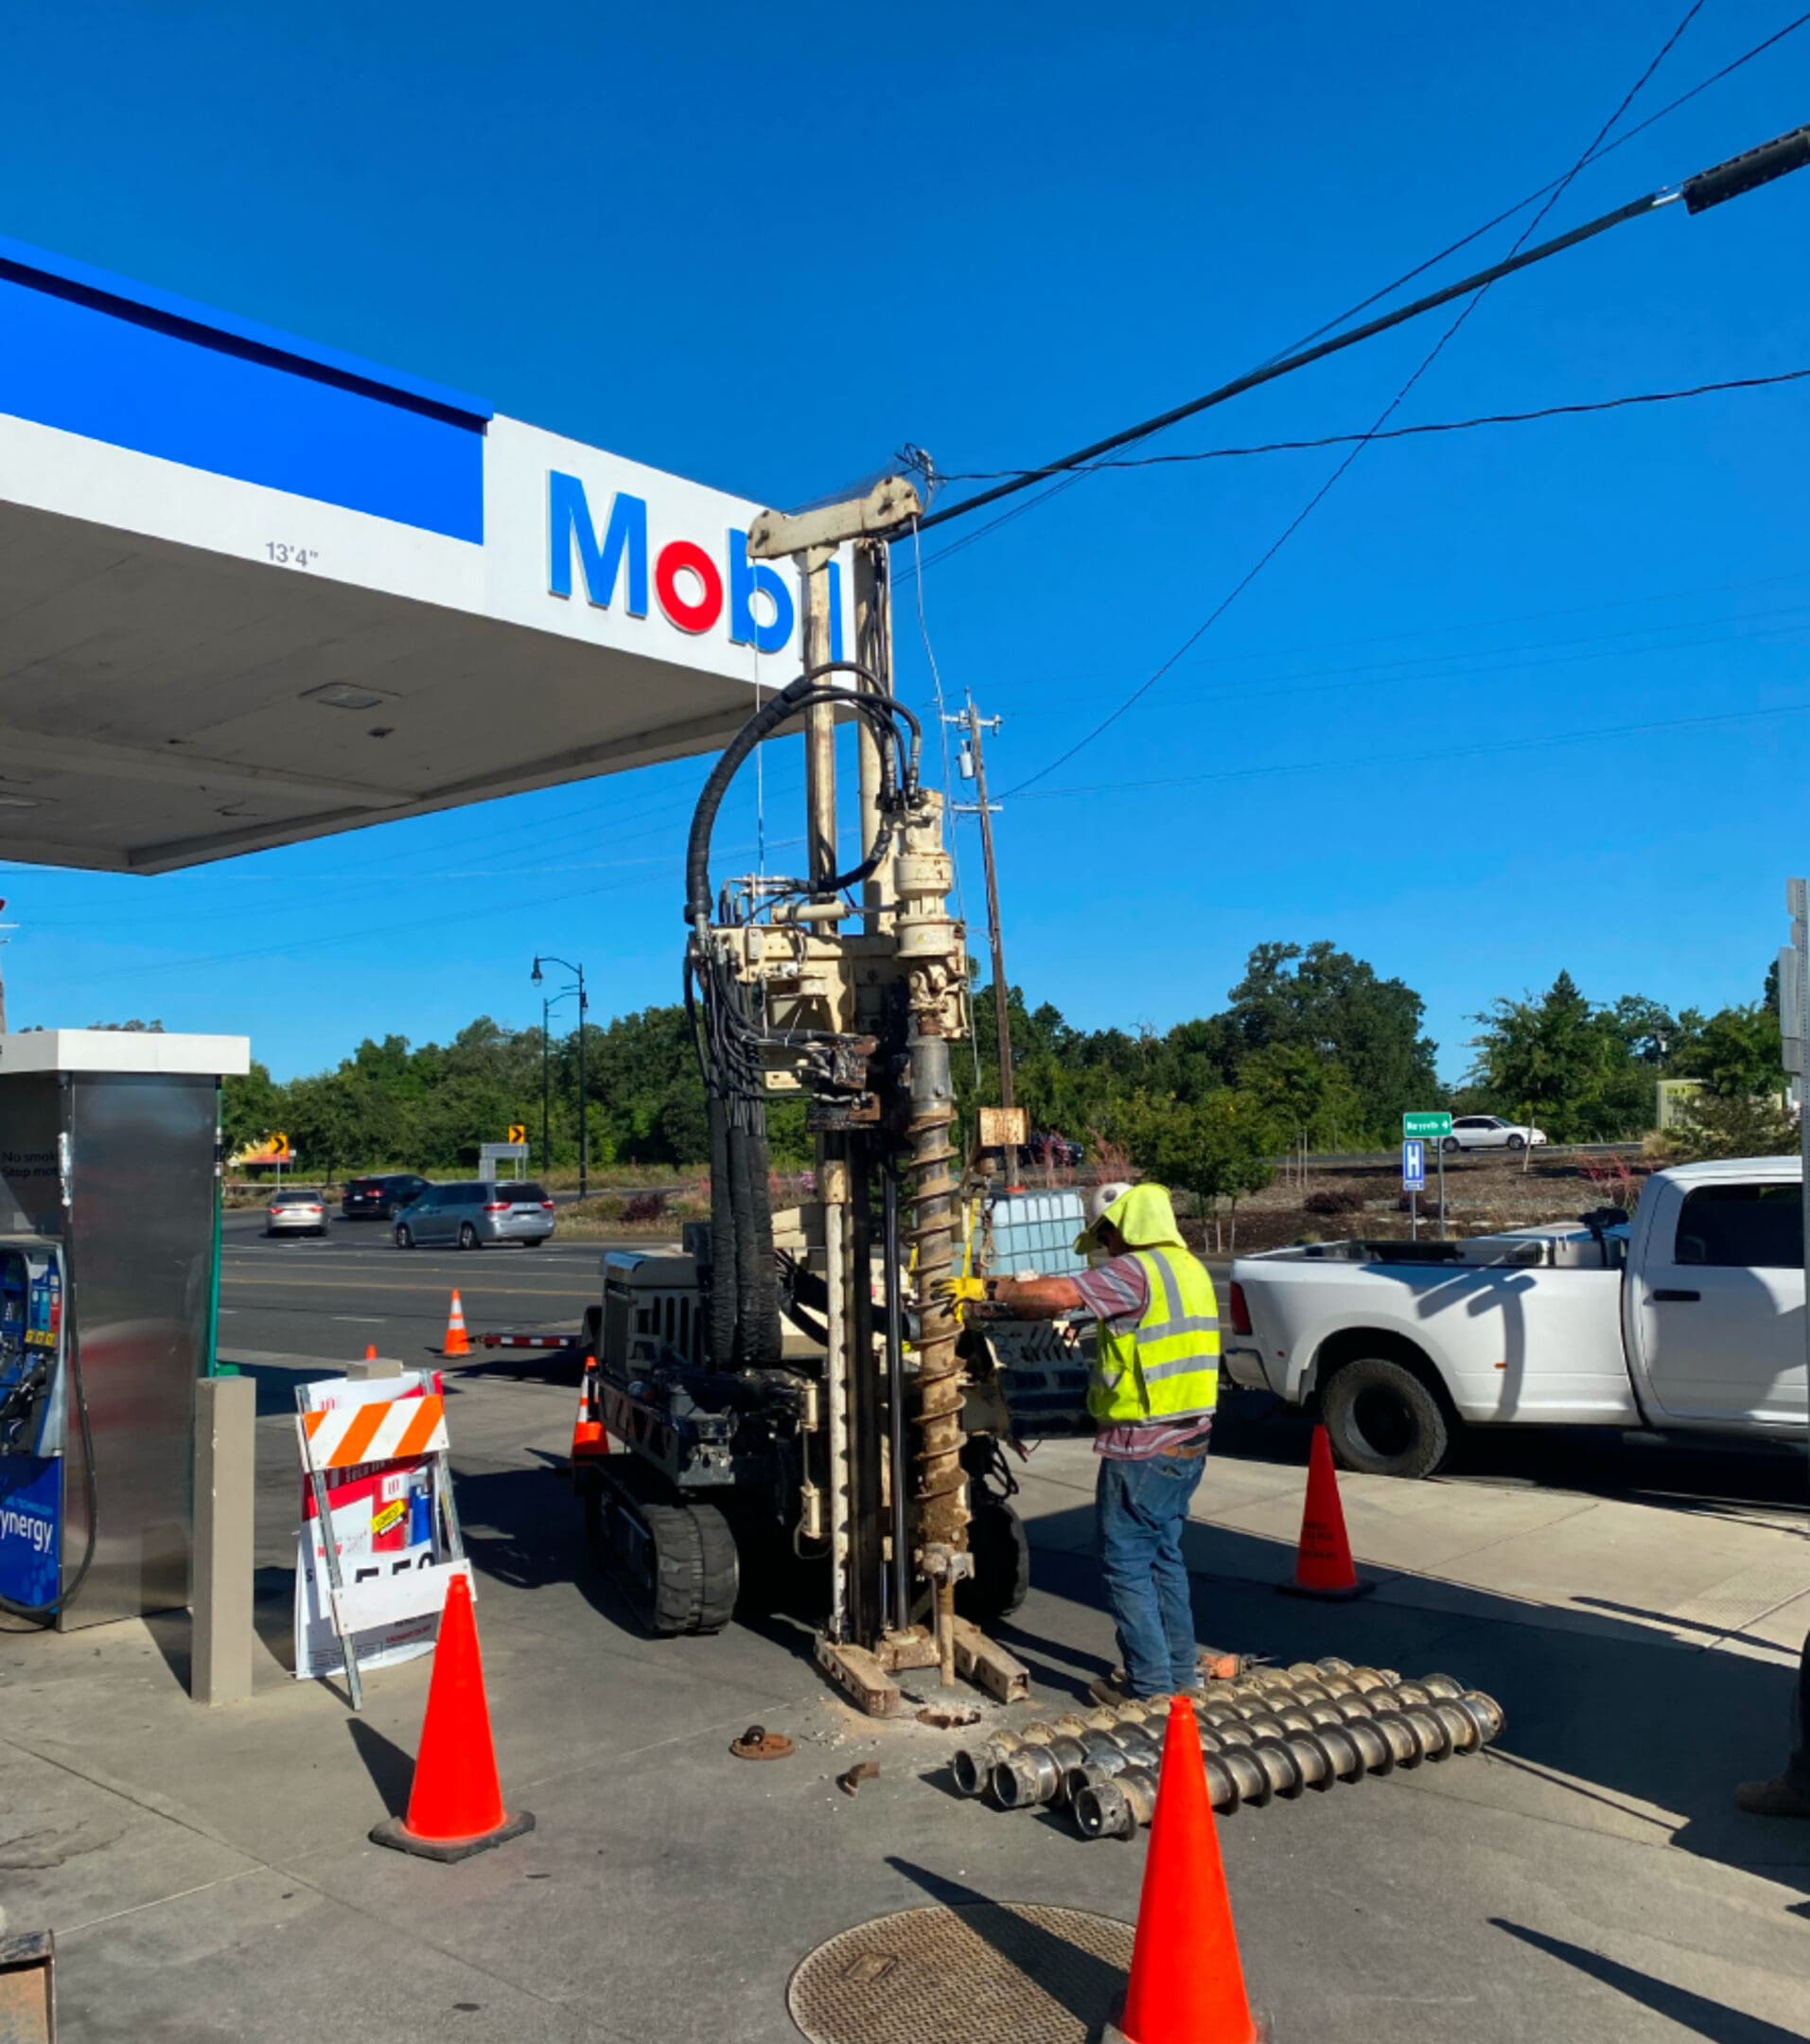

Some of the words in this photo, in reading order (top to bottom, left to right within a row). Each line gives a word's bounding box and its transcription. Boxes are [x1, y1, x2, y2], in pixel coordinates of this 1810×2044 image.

[265, 541, 319, 567] 13'4"
[547, 468, 845, 664] Mobl
[2, 1151, 21, 1163] No
[1407, 1144, 1420, 1179] H
